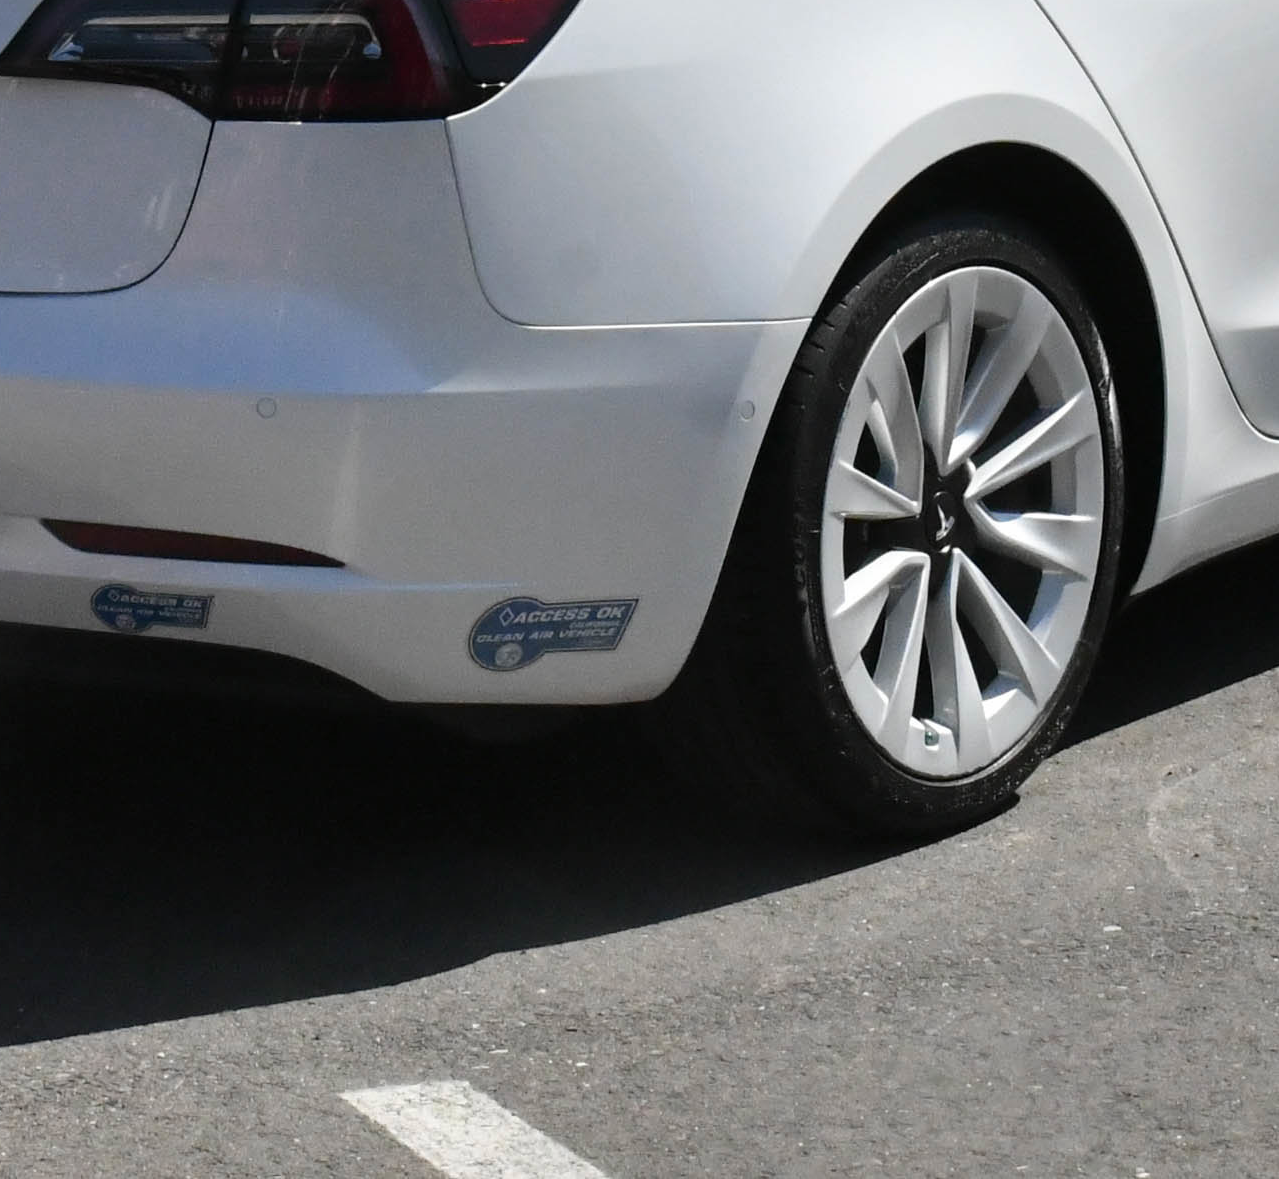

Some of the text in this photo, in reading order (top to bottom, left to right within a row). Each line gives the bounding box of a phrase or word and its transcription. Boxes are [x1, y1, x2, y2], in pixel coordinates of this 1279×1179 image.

[513, 605, 626, 624] ACCESS OK
[476, 627, 617, 644] CLEAN AIR VEHICLE
